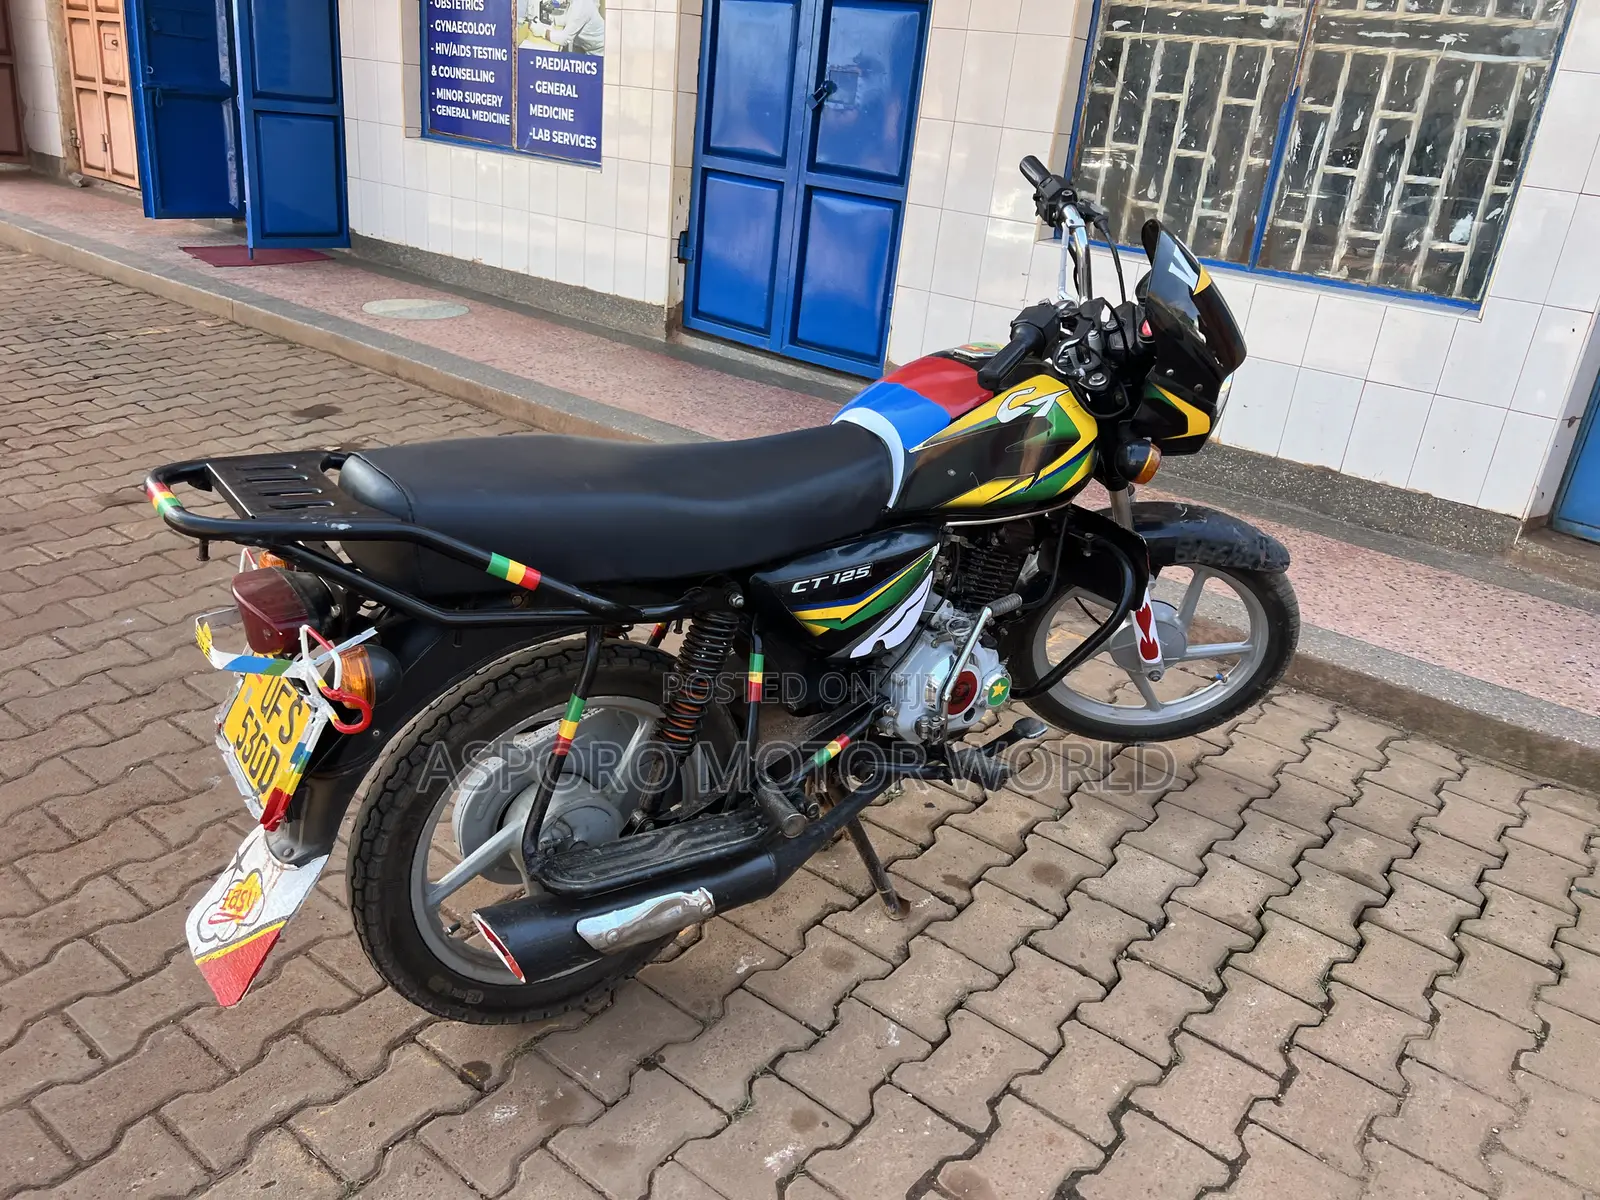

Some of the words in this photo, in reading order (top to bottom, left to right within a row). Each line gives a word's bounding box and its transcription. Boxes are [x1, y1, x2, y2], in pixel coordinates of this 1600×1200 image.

[435, 20, 496, 36] GYNAECOLOGY
[435, 42, 471, 58] HIV/AIDS
[472, 47, 508, 61] TESTING
[431, 65, 438, 76] &
[438, 66, 495, 83] COUNSELLING
[535, 56, 597, 75] PAEDIATRICS
[436, 88, 463, 103] MINOR
[464, 92, 503, 107] SURGERY
[535, 81, 578, 98] GENERAL
[436, 105, 471, 120] GENERAL
[472, 109, 510, 125] MEDICINE
[529, 104, 574, 122] MEDICINE
[552, 131, 597, 149] SERVICES
[791, 575, 828, 594] CT
[832, 565, 871, 585] 125
[261, 676, 303, 744] UFS
